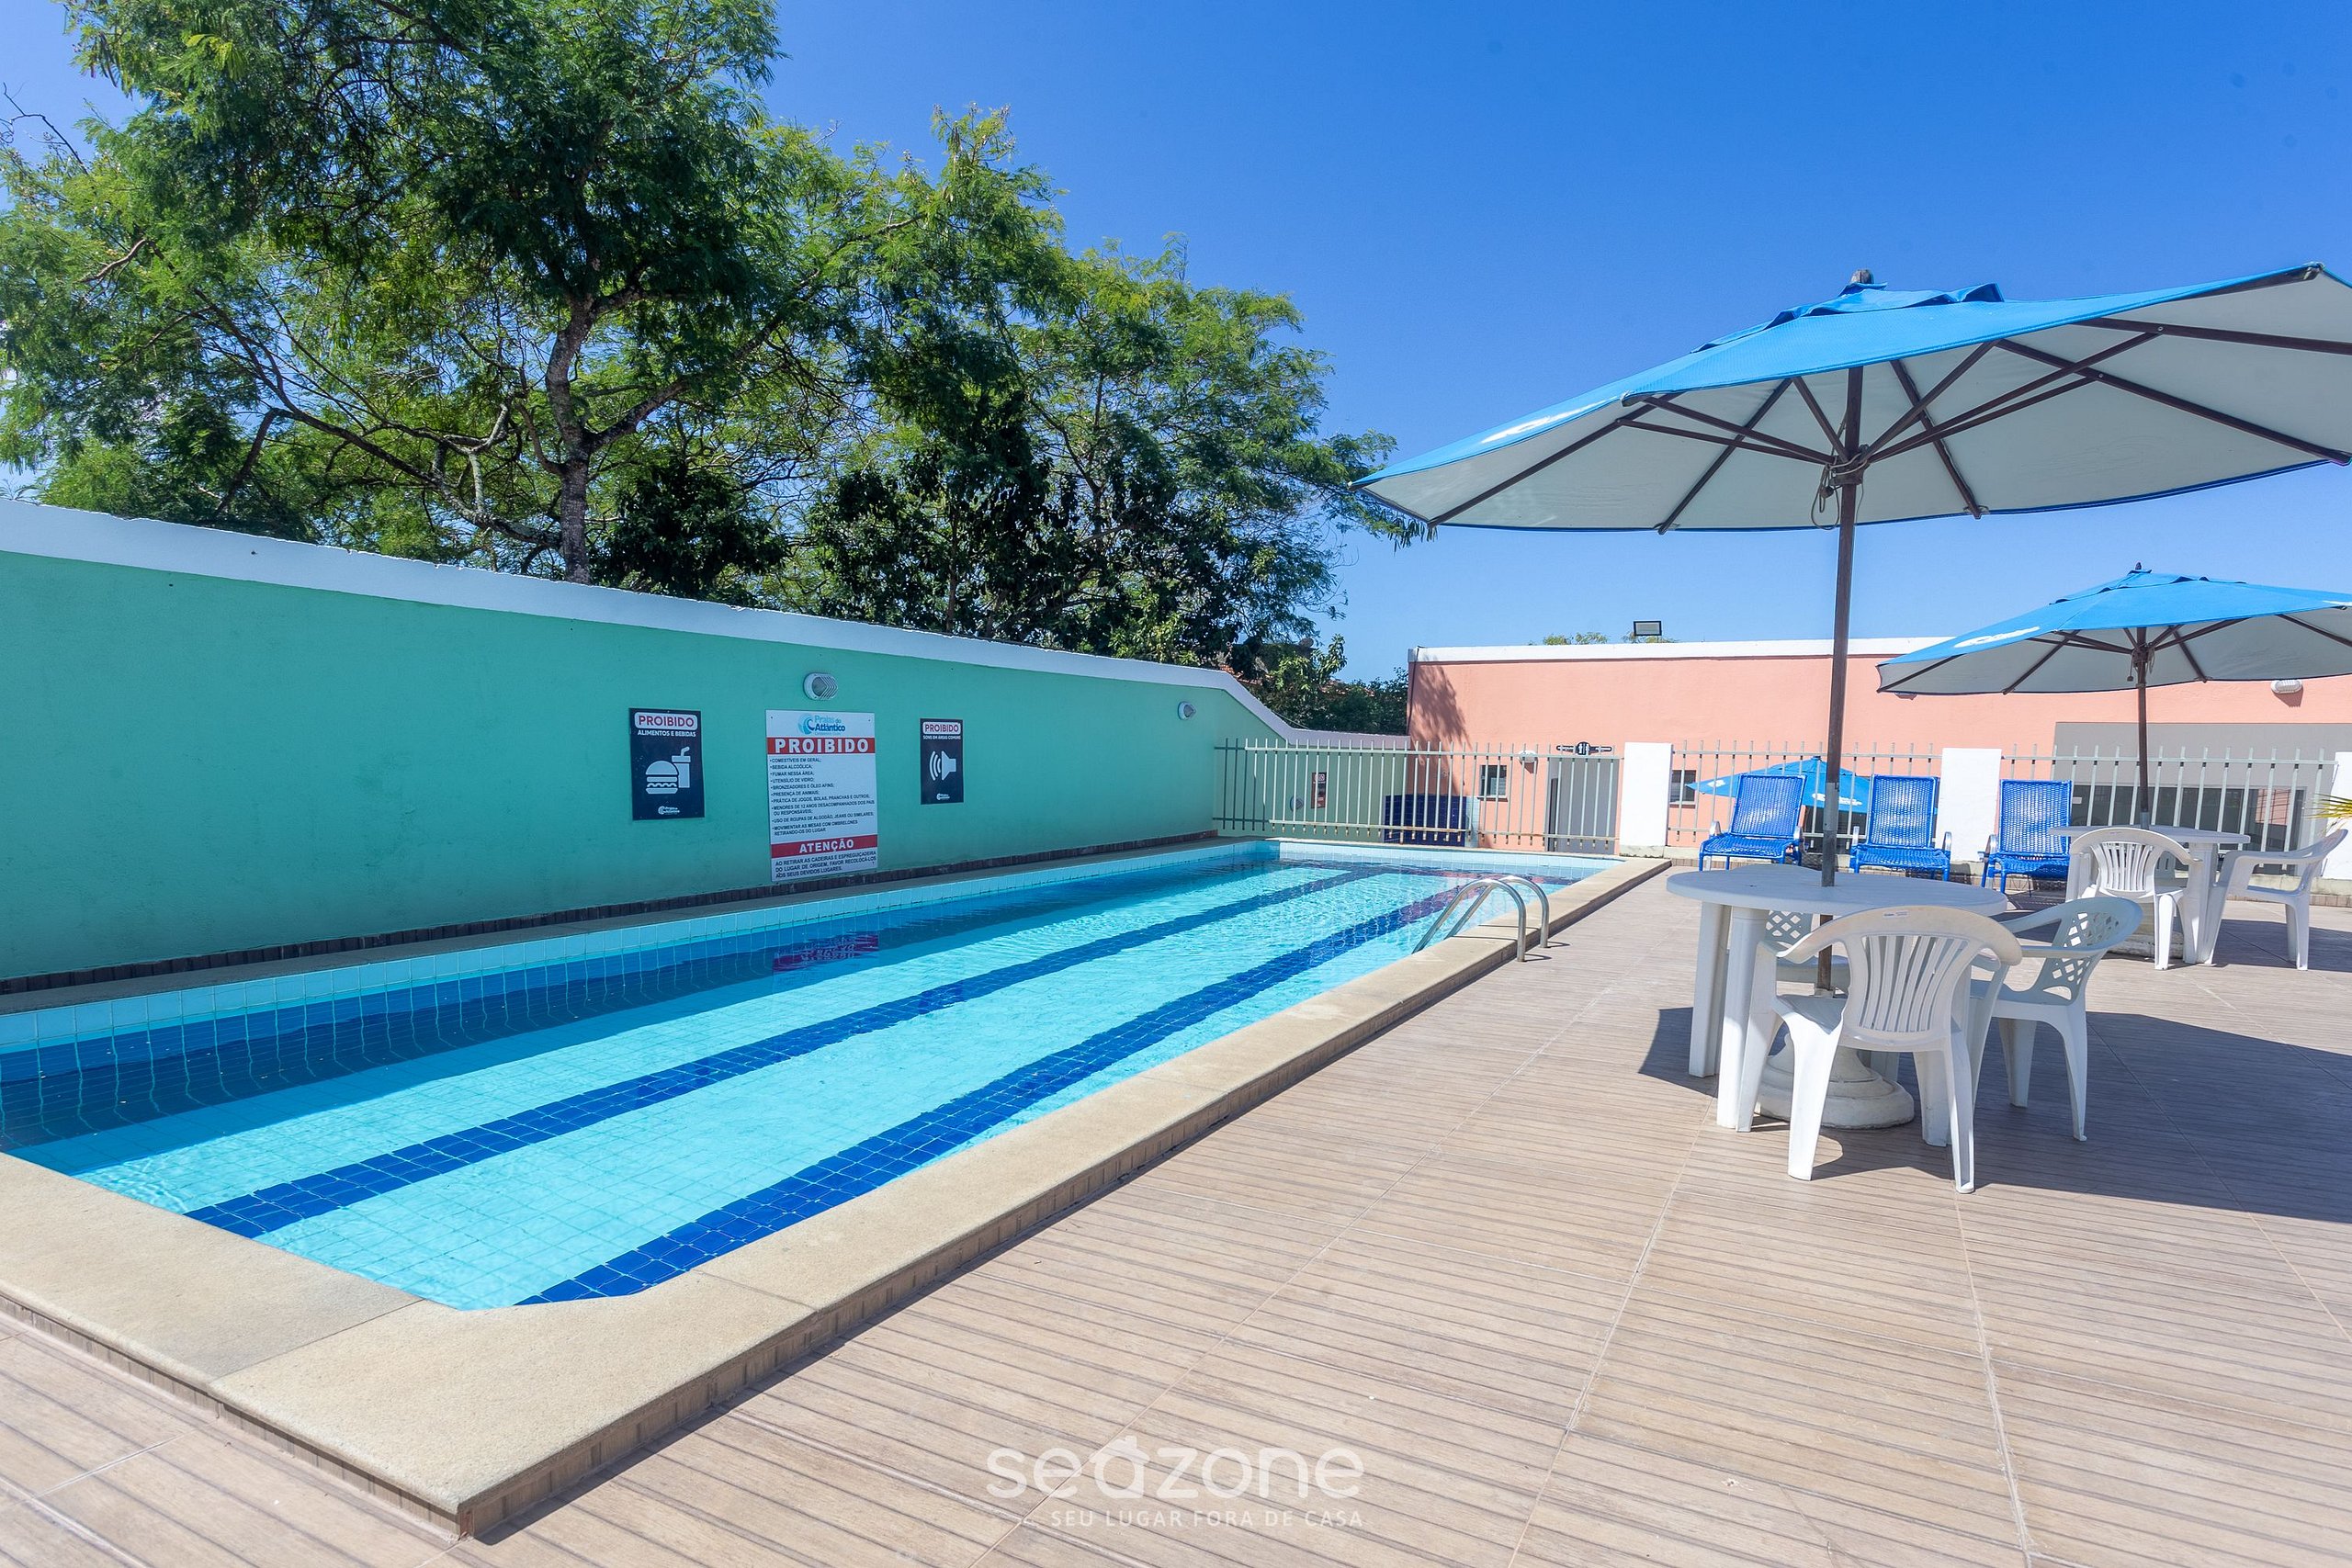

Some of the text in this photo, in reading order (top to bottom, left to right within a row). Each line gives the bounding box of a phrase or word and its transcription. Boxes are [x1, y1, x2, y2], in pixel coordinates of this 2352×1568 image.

[639, 716, 694, 727] PROIBIDO
[815, 723, 846, 732] Atlântico
[924, 724, 959, 733] PROIBIDO
[775, 739, 868, 753] PROIBIDO
[799, 838, 854, 852] ATENÇÃO
